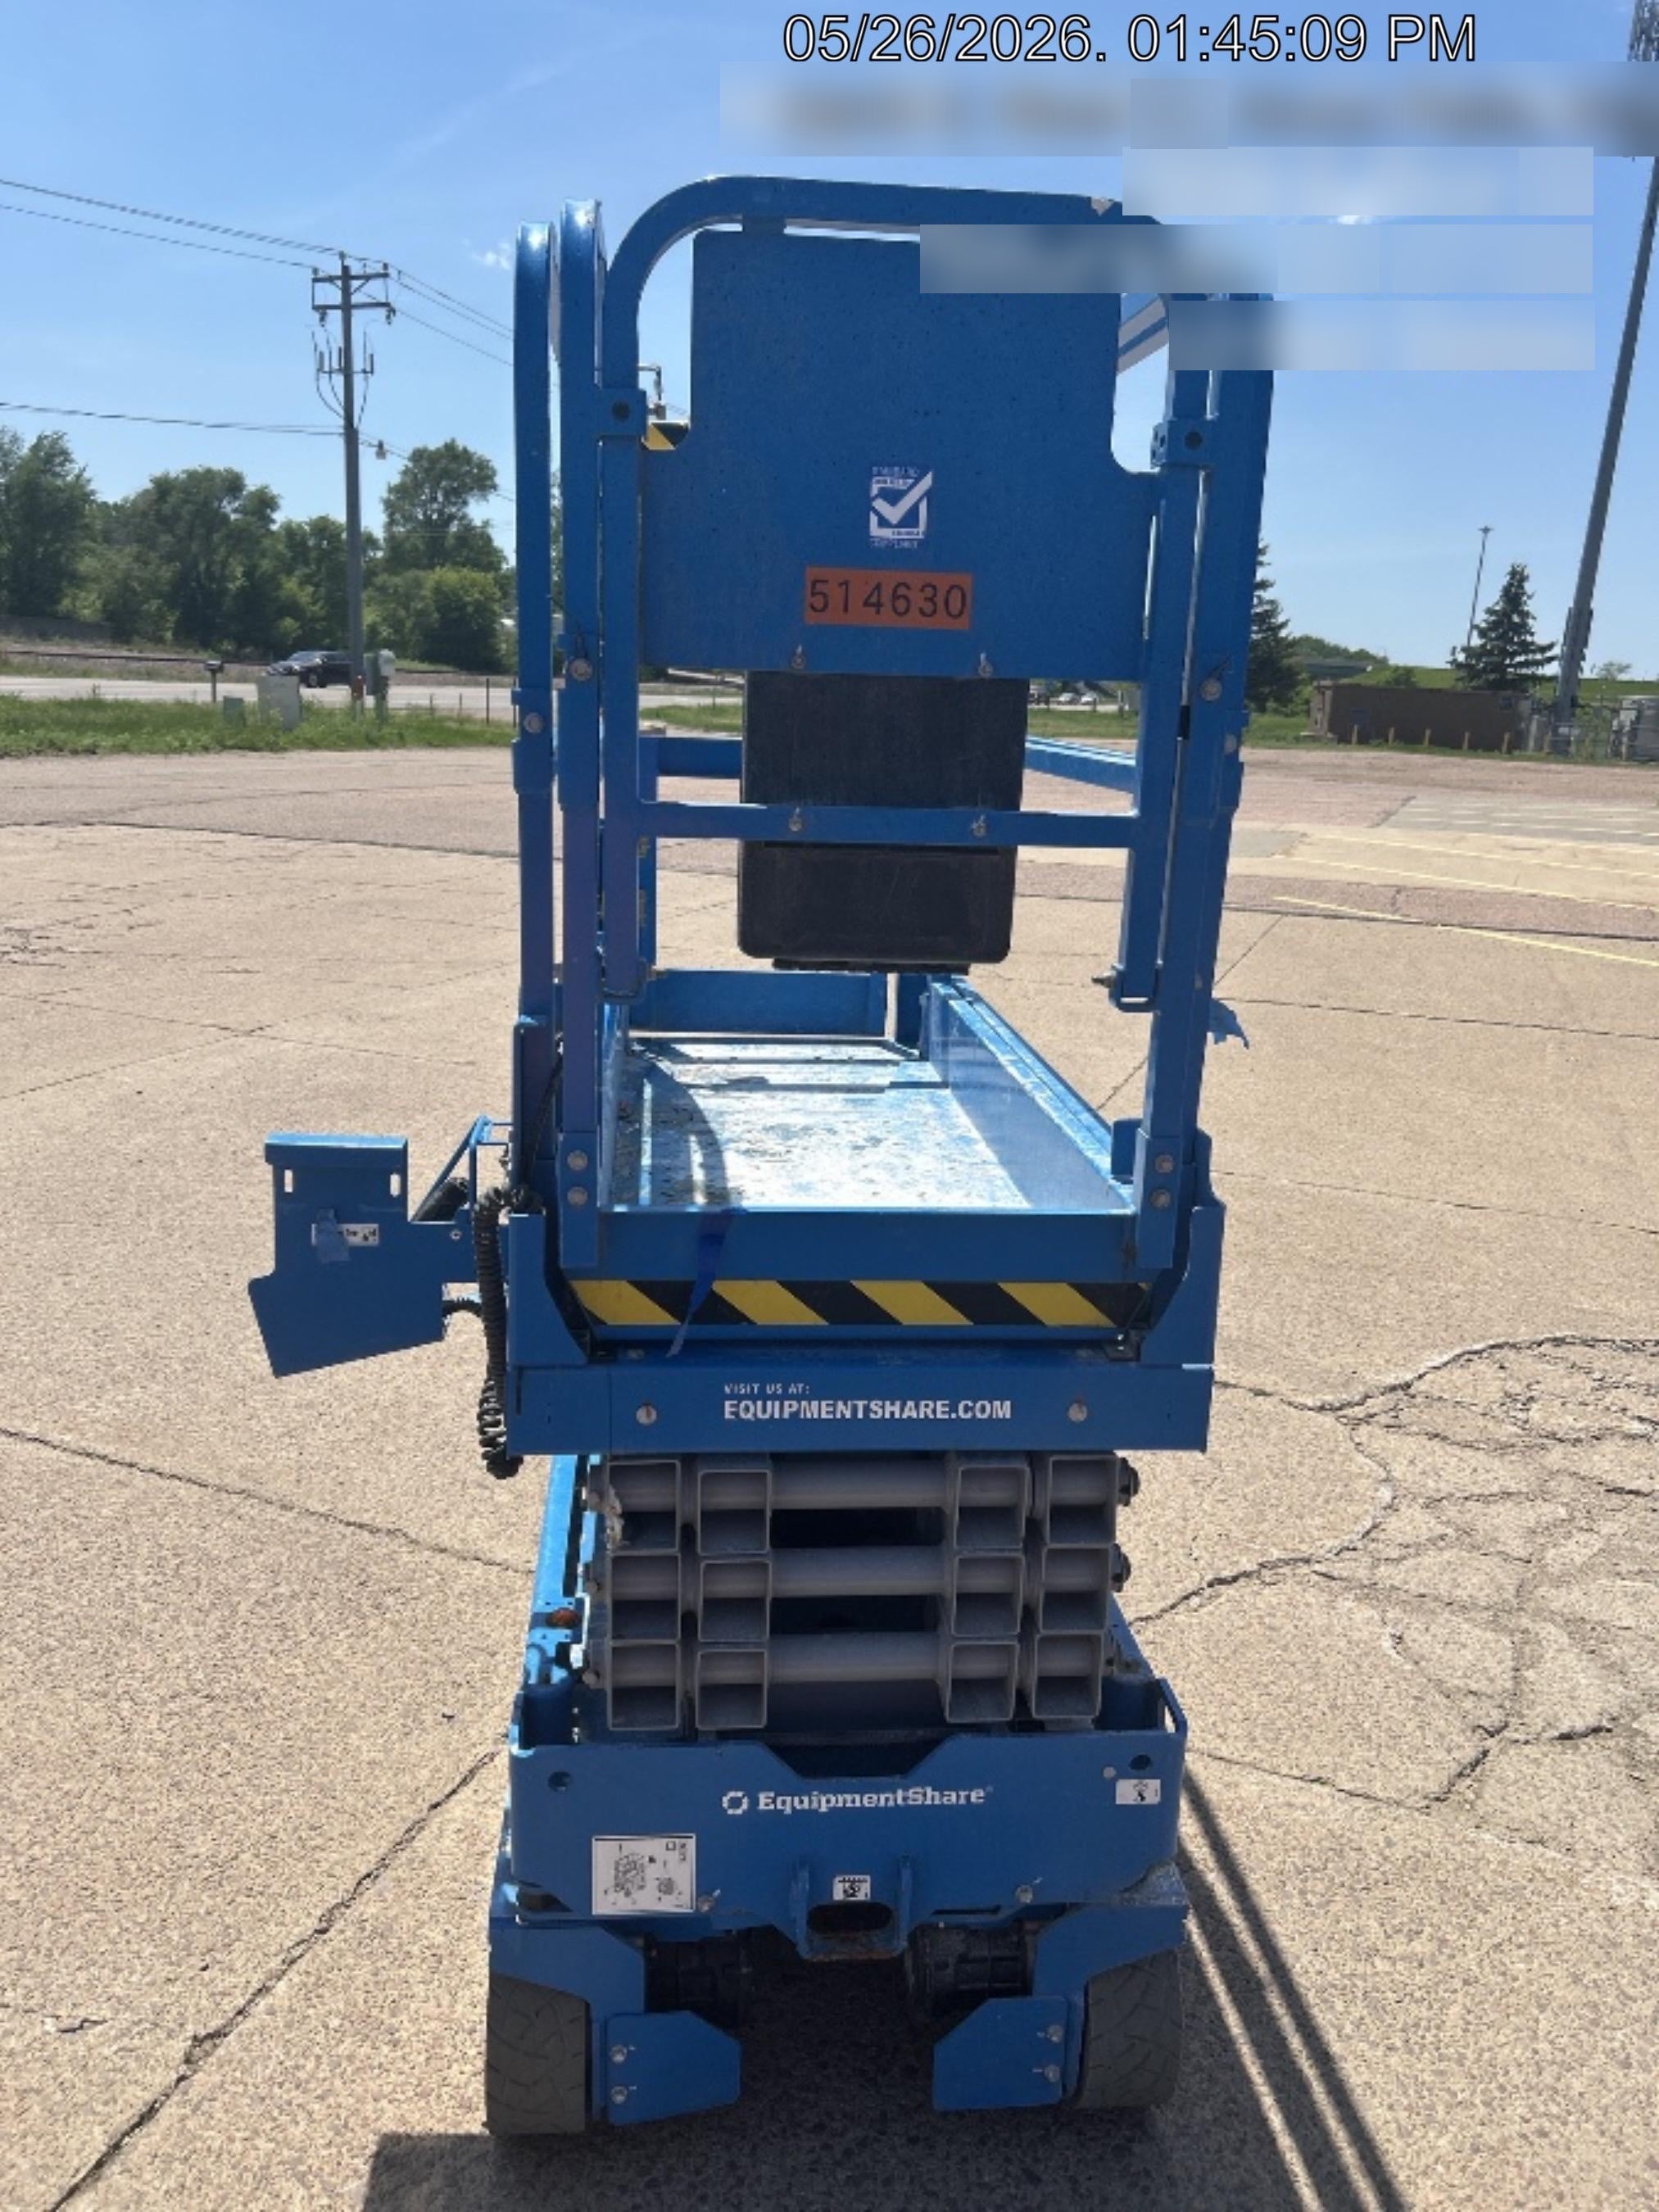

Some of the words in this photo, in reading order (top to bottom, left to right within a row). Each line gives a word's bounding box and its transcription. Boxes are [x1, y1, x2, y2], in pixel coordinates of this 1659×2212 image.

[809, 579, 967, 619] 514630
[724, 1383, 759, 1394] VISIT
[766, 1383, 782, 1394] US
[788, 1383, 810, 1394] AT:
[724, 1400, 1012, 1421] EQUIPMENTSHARE.COM
